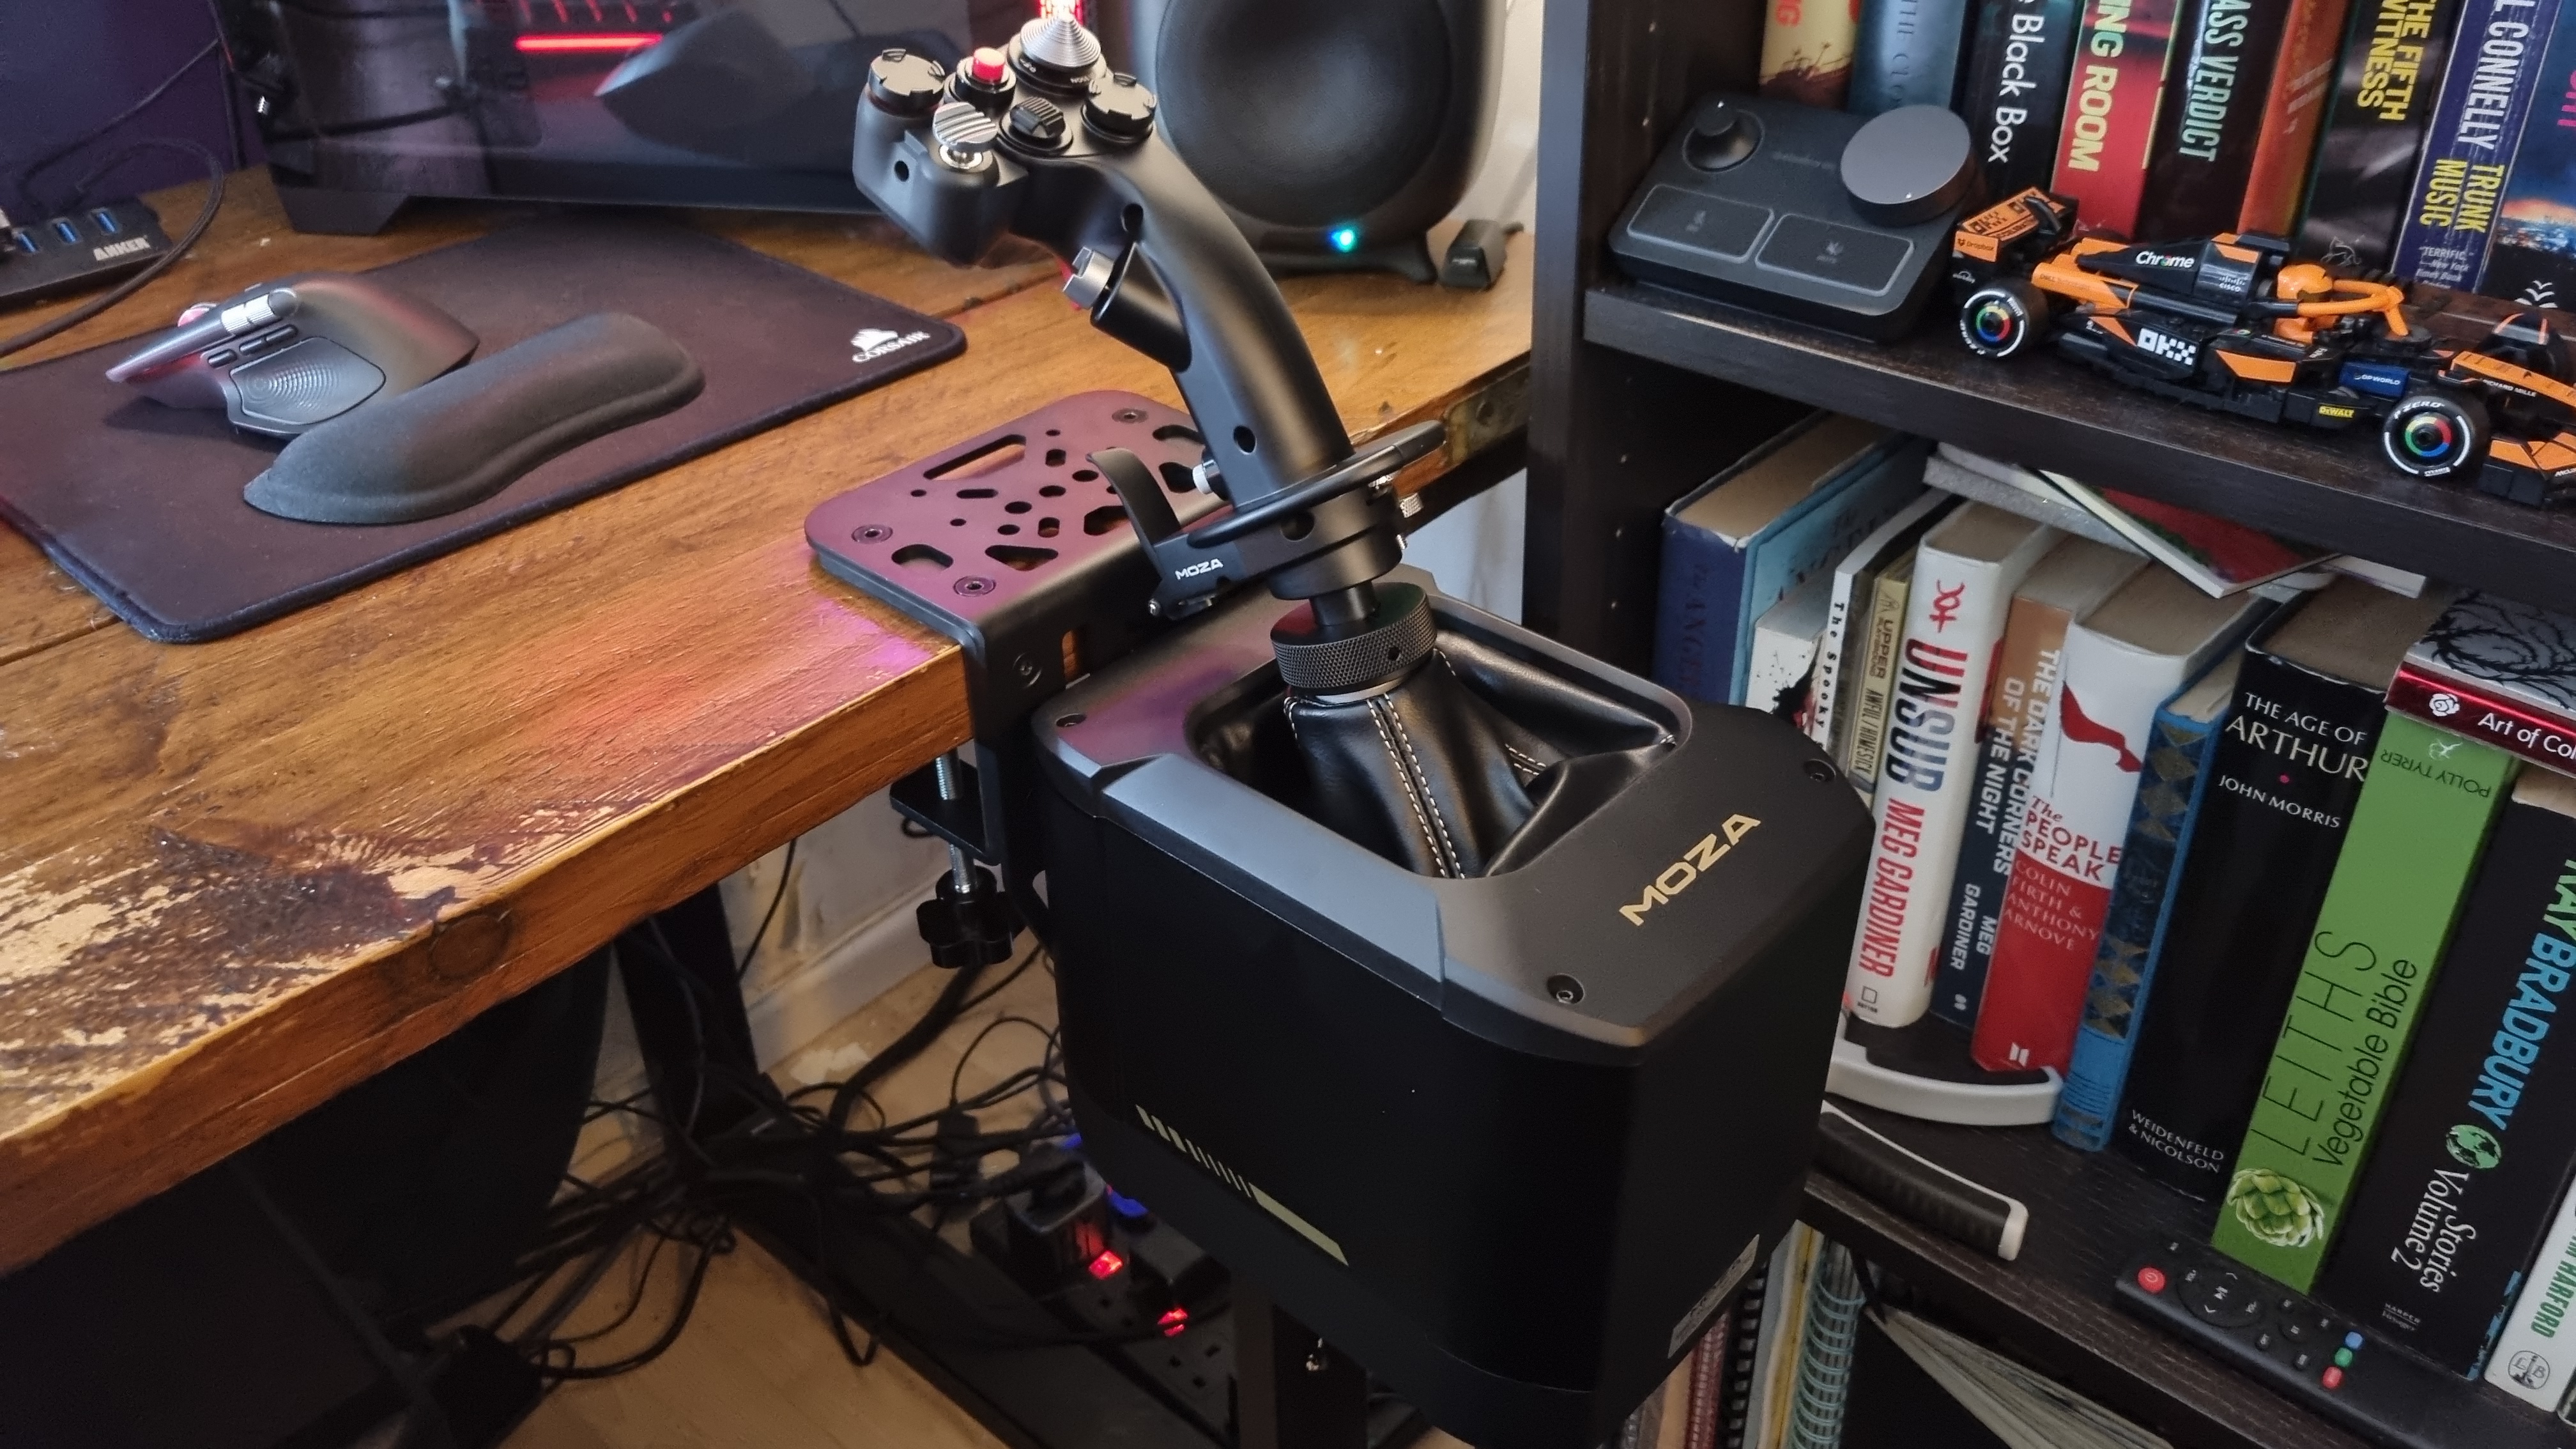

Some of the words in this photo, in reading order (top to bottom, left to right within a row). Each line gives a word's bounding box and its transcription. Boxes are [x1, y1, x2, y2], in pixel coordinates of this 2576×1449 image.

[1999, 13, 2045, 96] Black
[2179, 56, 2239, 162] VERDICT
[2379, 45, 2423, 120] FIFTH
[2457, 21, 2529, 150] CONNELLY
[1988, 106, 2028, 164] Box
[2068, 65, 2118, 172] ROOM
[2419, 159, 2467, 227] MUSIC
[2455, 165, 2505, 233] TRUNK
[93, 236, 151, 261] ANKER
[2136, 250, 2195, 268] Chrome
[2373, 376, 2401, 385] WORLD
[2514, 387, 2537, 397] MILLE
[1175, 558, 1223, 580] MOZA
[1828, 602, 1845, 638] The
[1880, 618, 1894, 680] UPPER
[2033, 649, 2061, 691] THE
[1886, 639, 1968, 792] UNSUB
[2002, 677, 2025, 710] OF
[2244, 693, 2281, 719] THE
[2285, 711, 2327, 737] AGE
[2334, 726, 2368, 746] OF
[1991, 712, 2016, 762] THE
[2018, 694, 2047, 768] DARK
[2225, 715, 2370, 783] ARTHUR
[2478, 712, 2513, 735] Art
[2517, 728, 2542, 748] of
[2380, 749, 2431, 779] TYRER
[2435, 769, 2492, 798] POLLY
[1976, 764, 2005, 834] NIGHT
[1993, 767, 2034, 877] CORNERS
[2032, 795, 2063, 822] The
[2218, 775, 2266, 803] JOHN
[2269, 798, 2342, 829] MORRIS
[1880, 798, 1925, 859] MEG
[2026, 809, 2122, 864] PEOPLE
[1618, 812, 1761, 926] MOZA
[2016, 860, 2072, 896] COLIN
[2021, 830, 2104, 882] SPEAK
[1859, 855, 1913, 977] GARDINER
[2007, 893, 2100, 940] ANTHONY
[2012, 876, 2062, 911] FIRTH
[2069, 906, 2082, 919] &
[1950, 883, 1981, 970] GARDINER
[1976, 915, 1998, 956] MEG
[2004, 908, 2075, 951] ARNOVE
[2251, 931, 2377, 1156] LEITHS
[2467, 932, 2576, 1131] BRADBURY
[2312, 1033, 2389, 1167] Vegetable
[2366, 958, 2417, 1029] Bible
[2132, 1109, 2224, 1161] WEIDENFELD
[2140, 1131, 2220, 1174] NICOLSON
[2405, 1169, 2469, 1254] Volume
[2391, 1246, 2423, 1271] 2
[2419, 1215, 2477, 1293] Stories
